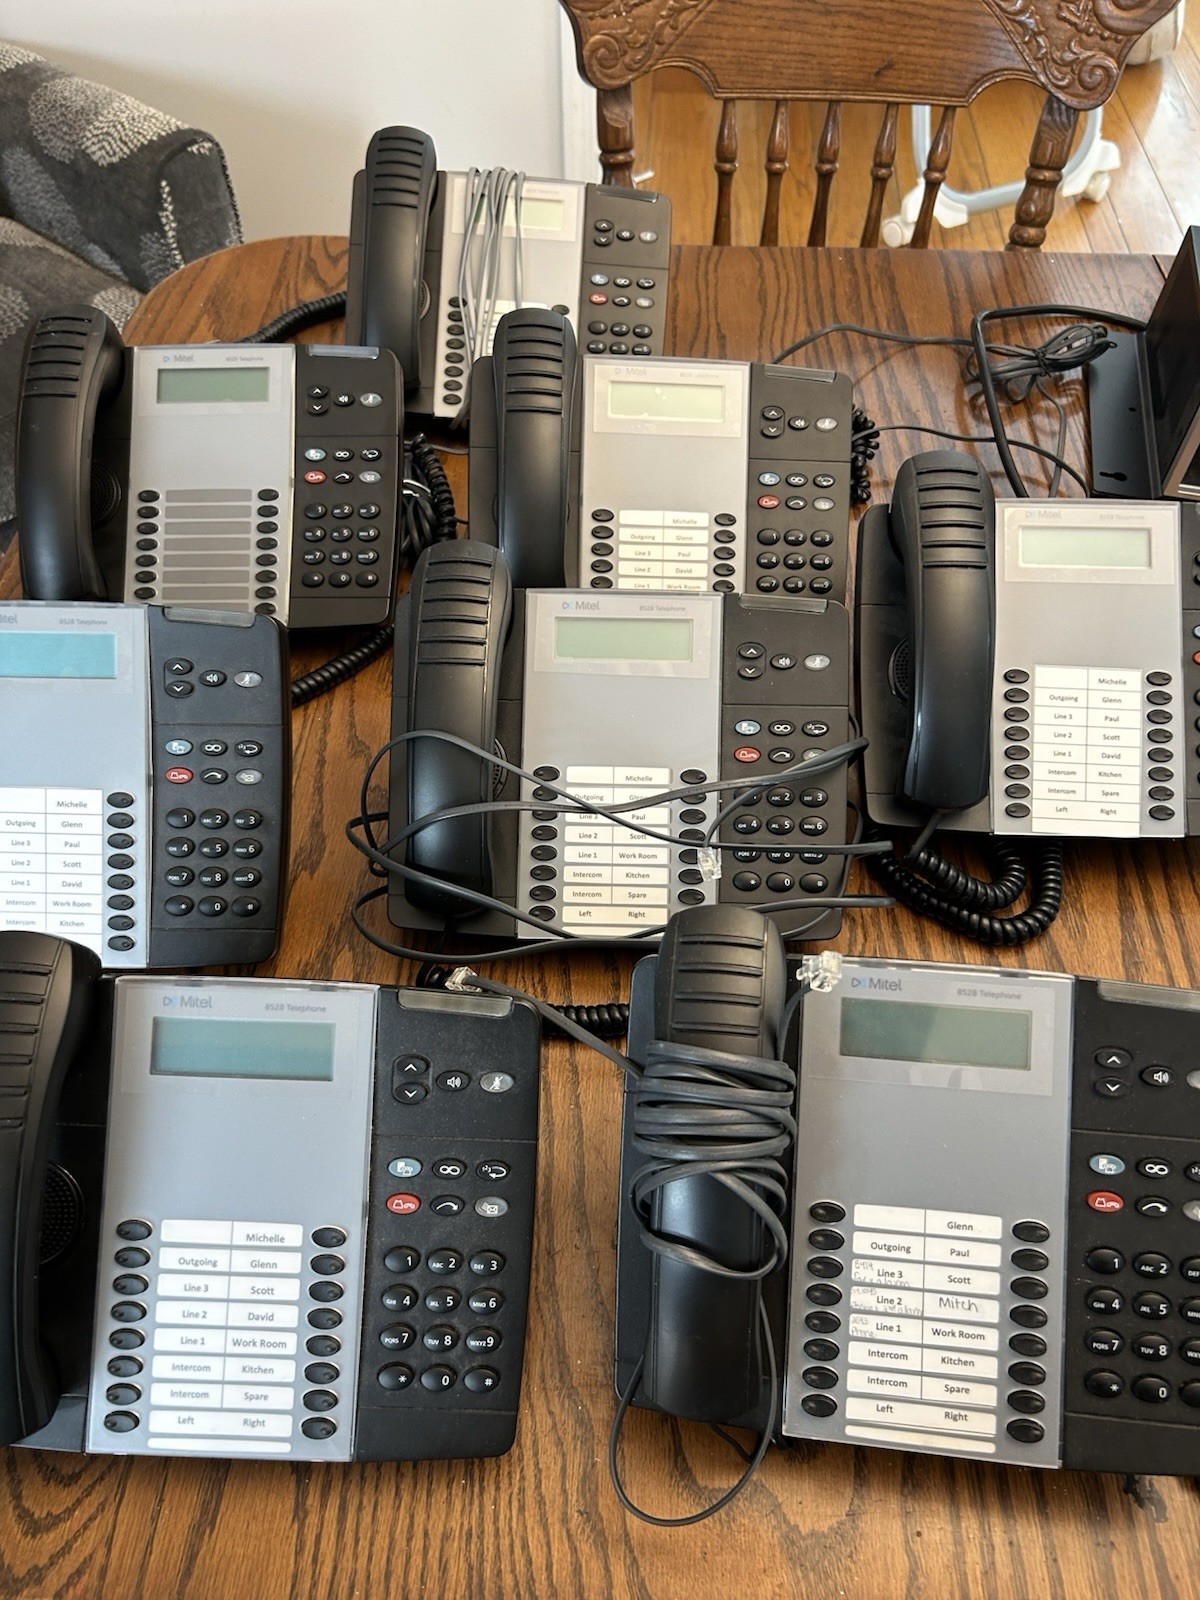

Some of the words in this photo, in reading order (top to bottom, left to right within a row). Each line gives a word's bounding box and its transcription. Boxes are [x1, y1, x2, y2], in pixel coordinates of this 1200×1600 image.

[575, 601, 599, 610] Mitel
[1049, 694, 1078, 702] Outgoing
[1102, 790, 1119, 798] Spare
[1100, 808, 1116, 816] Right
[6, 820, 36, 828] Outgoing
[63, 860, 81, 868] Scott
[628, 911, 645, 919] Right
[869, 978, 902, 992] Mitel
[957, 988, 977, 997] 8528
[979, 990, 1021, 1000] Telephone
[181, 996, 212, 1009] Mitel
[286, 1004, 326, 1013] Telephone
[947, 1222, 973, 1231] Glenn
[246, 1233, 285, 1243] Michelle
[871, 1243, 911, 1254] Outgoing
[950, 1248, 970, 1258] Paul
[178, 1257, 217, 1268] Outgoing
[250, 1259, 277, 1269] Glenn
[407, 1256, 411, 1266] 1
[449, 1259, 455, 1268] 2
[491, 1261, 497, 1270] 3
[1114, 1258, 1119, 1268] 1
[877, 1269, 895, 1278] Line
[897, 1271, 902, 1279] 3
[1159, 1264, 1167, 1274] 2
[948, 1275, 971, 1285] Scott
[184, 1283, 201, 1292] Line
[203, 1284, 209, 1293] 3
[251, 1286, 274, 1295] Scott
[403, 1296, 410, 1305] 4
[447, 1297, 453, 1306] 5
[489, 1298, 496, 1307] 6
[877, 1296, 894, 1305] Line
[896, 1297, 902, 1306] 2
[939, 1297, 979, 1313] Mitch
[1112, 1299, 1119, 1309] 4
[182, 1309, 200, 1319] Line
[202, 1311, 207, 1320] 2
[1160, 1304, 1167, 1315] 5
[248, 1312, 274, 1322] David
[876, 1323, 893, 1332] Line
[896, 1324, 901, 1332] 1
[402, 1333, 408, 1343] 7
[931, 1328, 956, 1339] Work
[958, 1331, 985, 1341] Room
[181, 1336, 198, 1345] Line
[201, 1337, 205, 1346] 1
[232, 1338, 258, 1348] Work
[261, 1339, 287, 1349] Room
[444, 1336, 451, 1345] 8
[487, 1337, 494, 1346] 9
[1112, 1340, 1119, 1351] 7
[868, 1349, 908, 1361] Intercom
[1159, 1346, 1167, 1356] 8
[941, 1357, 975, 1367] Kitchen
[172, 1363, 211, 1373] Intercom
[242, 1365, 274, 1375] Kitchen
[442, 1376, 449, 1385] 0
[867, 1376, 907, 1388] Intercom
[170, 1389, 209, 1399] Intercom
[944, 1384, 970, 1395] Spare
[1159, 1388, 1167, 1397] 0
[244, 1392, 268, 1403] Spare
[876, 1404, 894, 1413] Left
[178, 1416, 194, 1425] Left
[944, 1411, 968, 1423] Right
[243, 1418, 265, 1429] Right
